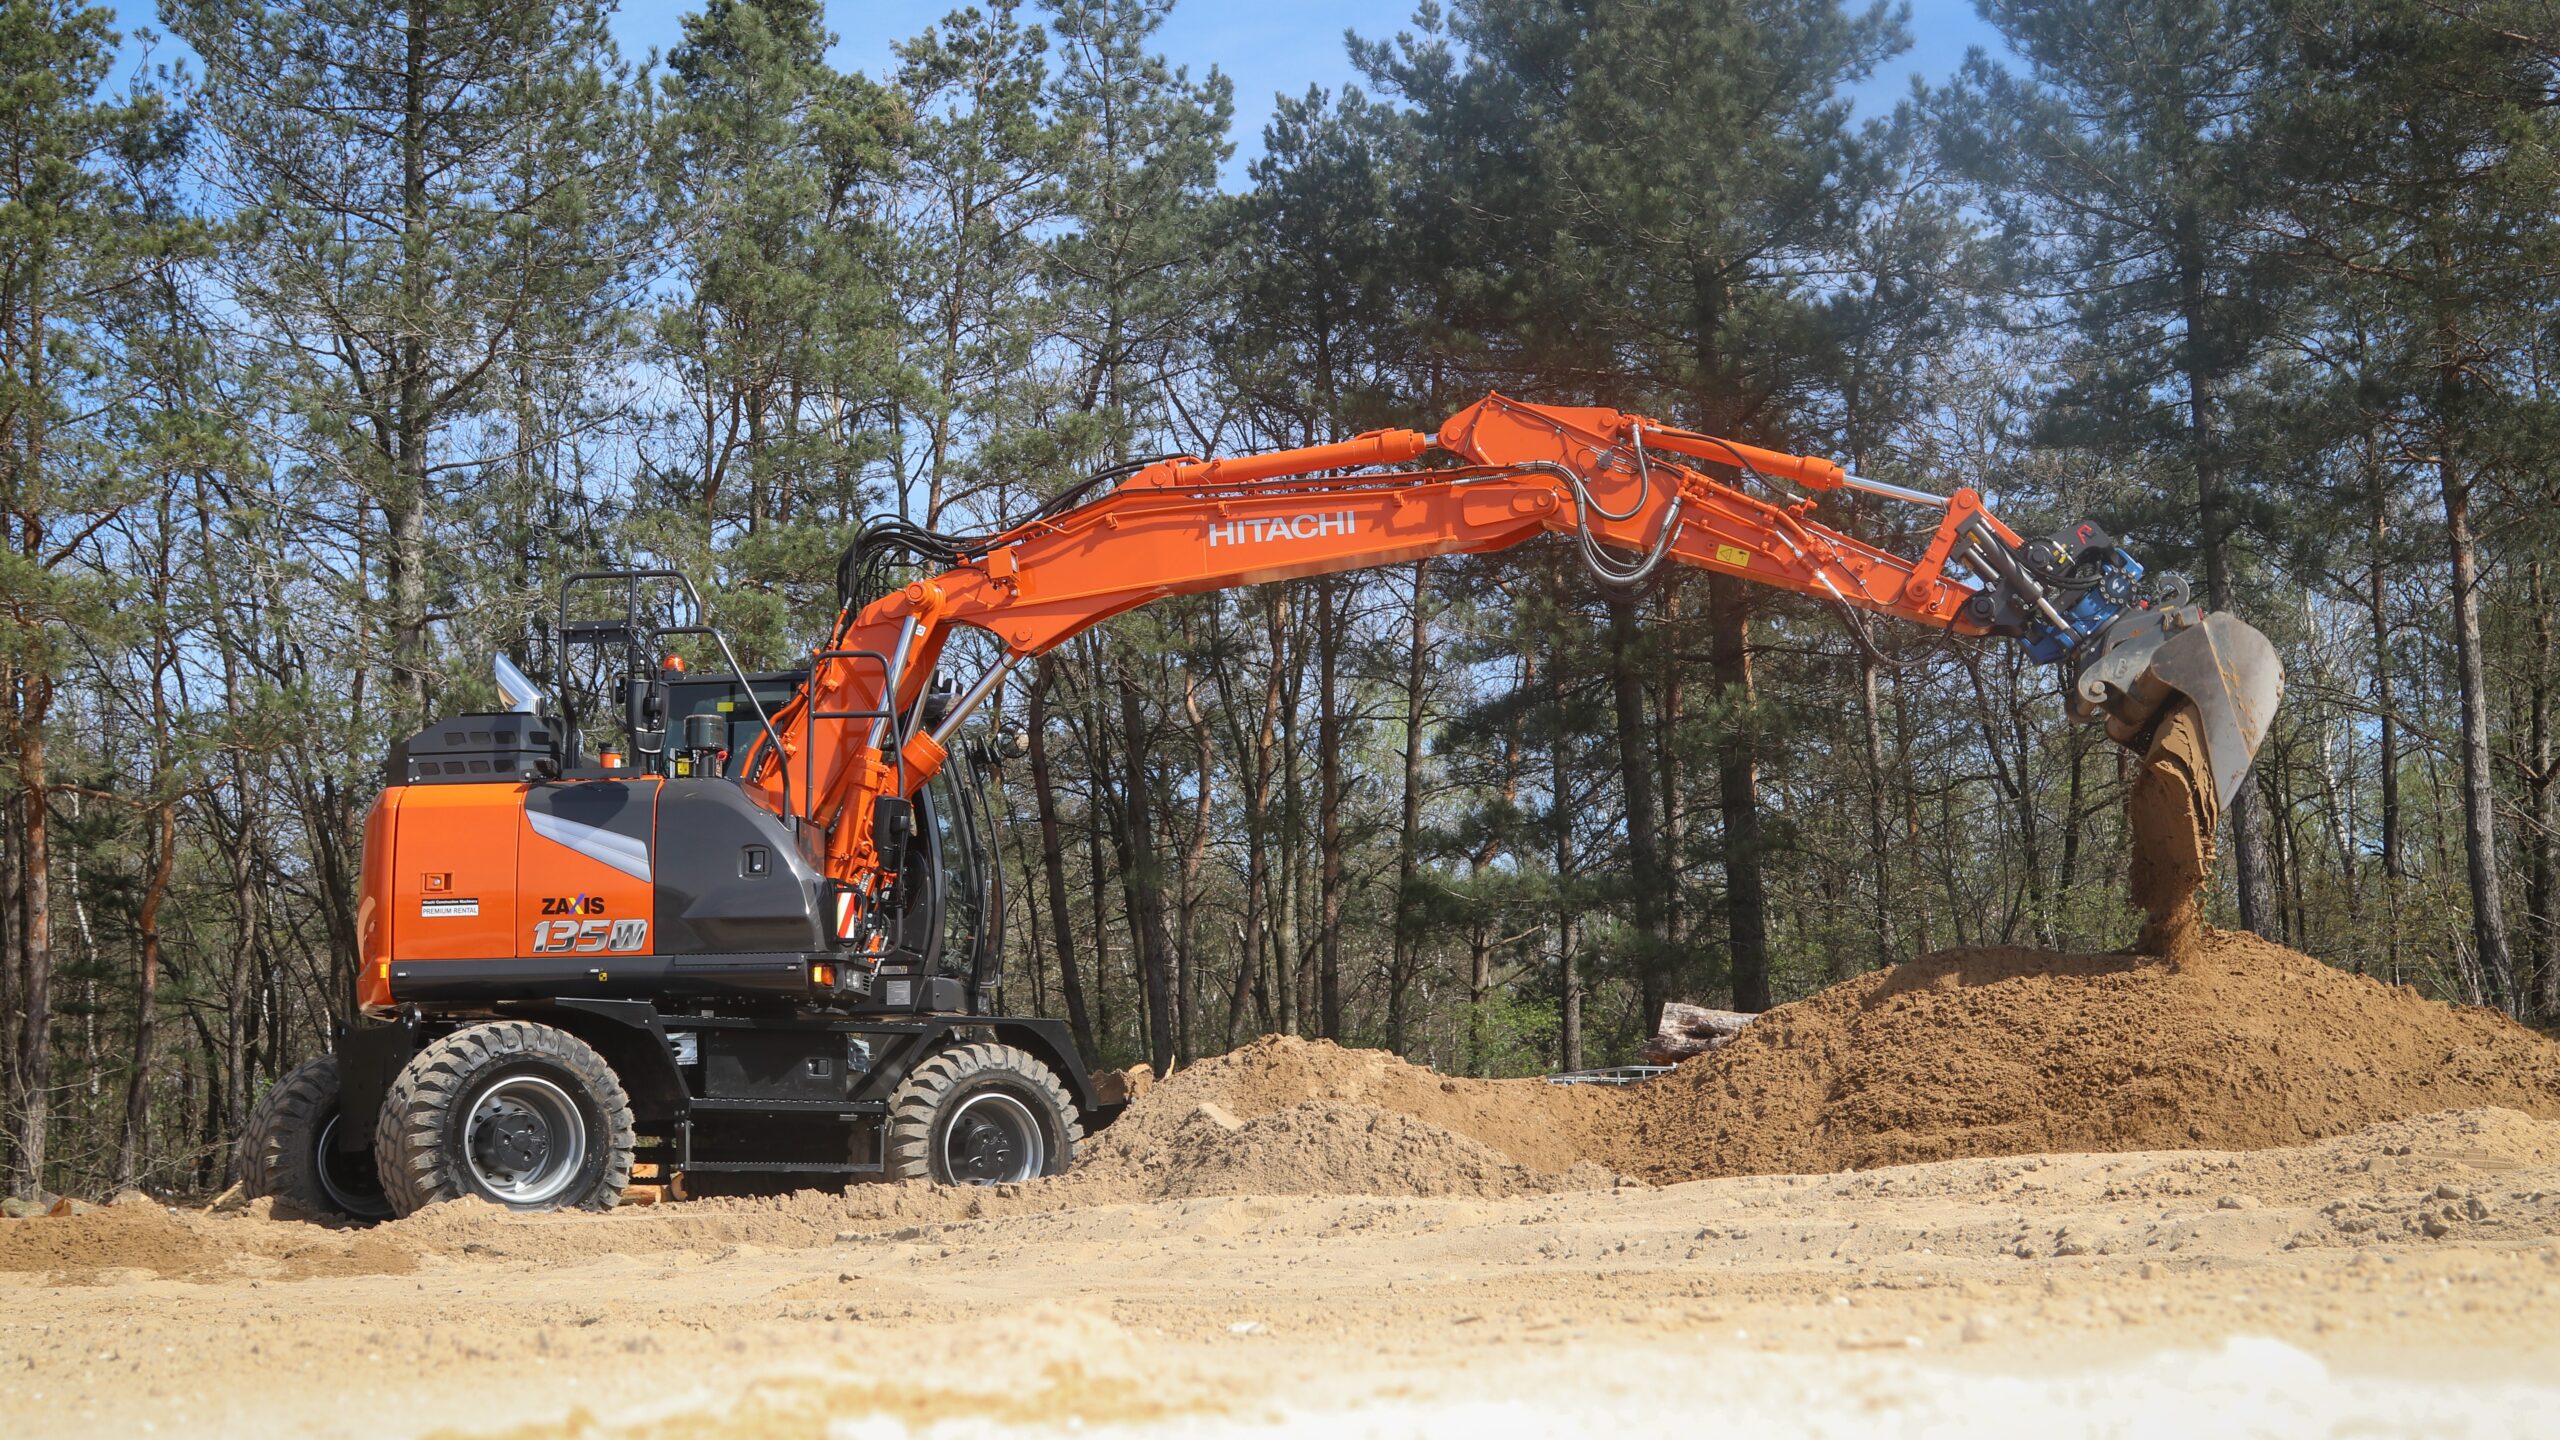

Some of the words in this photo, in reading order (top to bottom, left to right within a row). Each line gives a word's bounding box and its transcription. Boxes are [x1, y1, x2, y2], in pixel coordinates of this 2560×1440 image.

[1209, 510, 1355, 547] HITACHI
[422, 907, 452, 915] PREMIUM
[453, 906, 477, 914] RENTAL
[541, 893, 605, 915] ZAXIS
[532, 918, 649, 953] 135W
